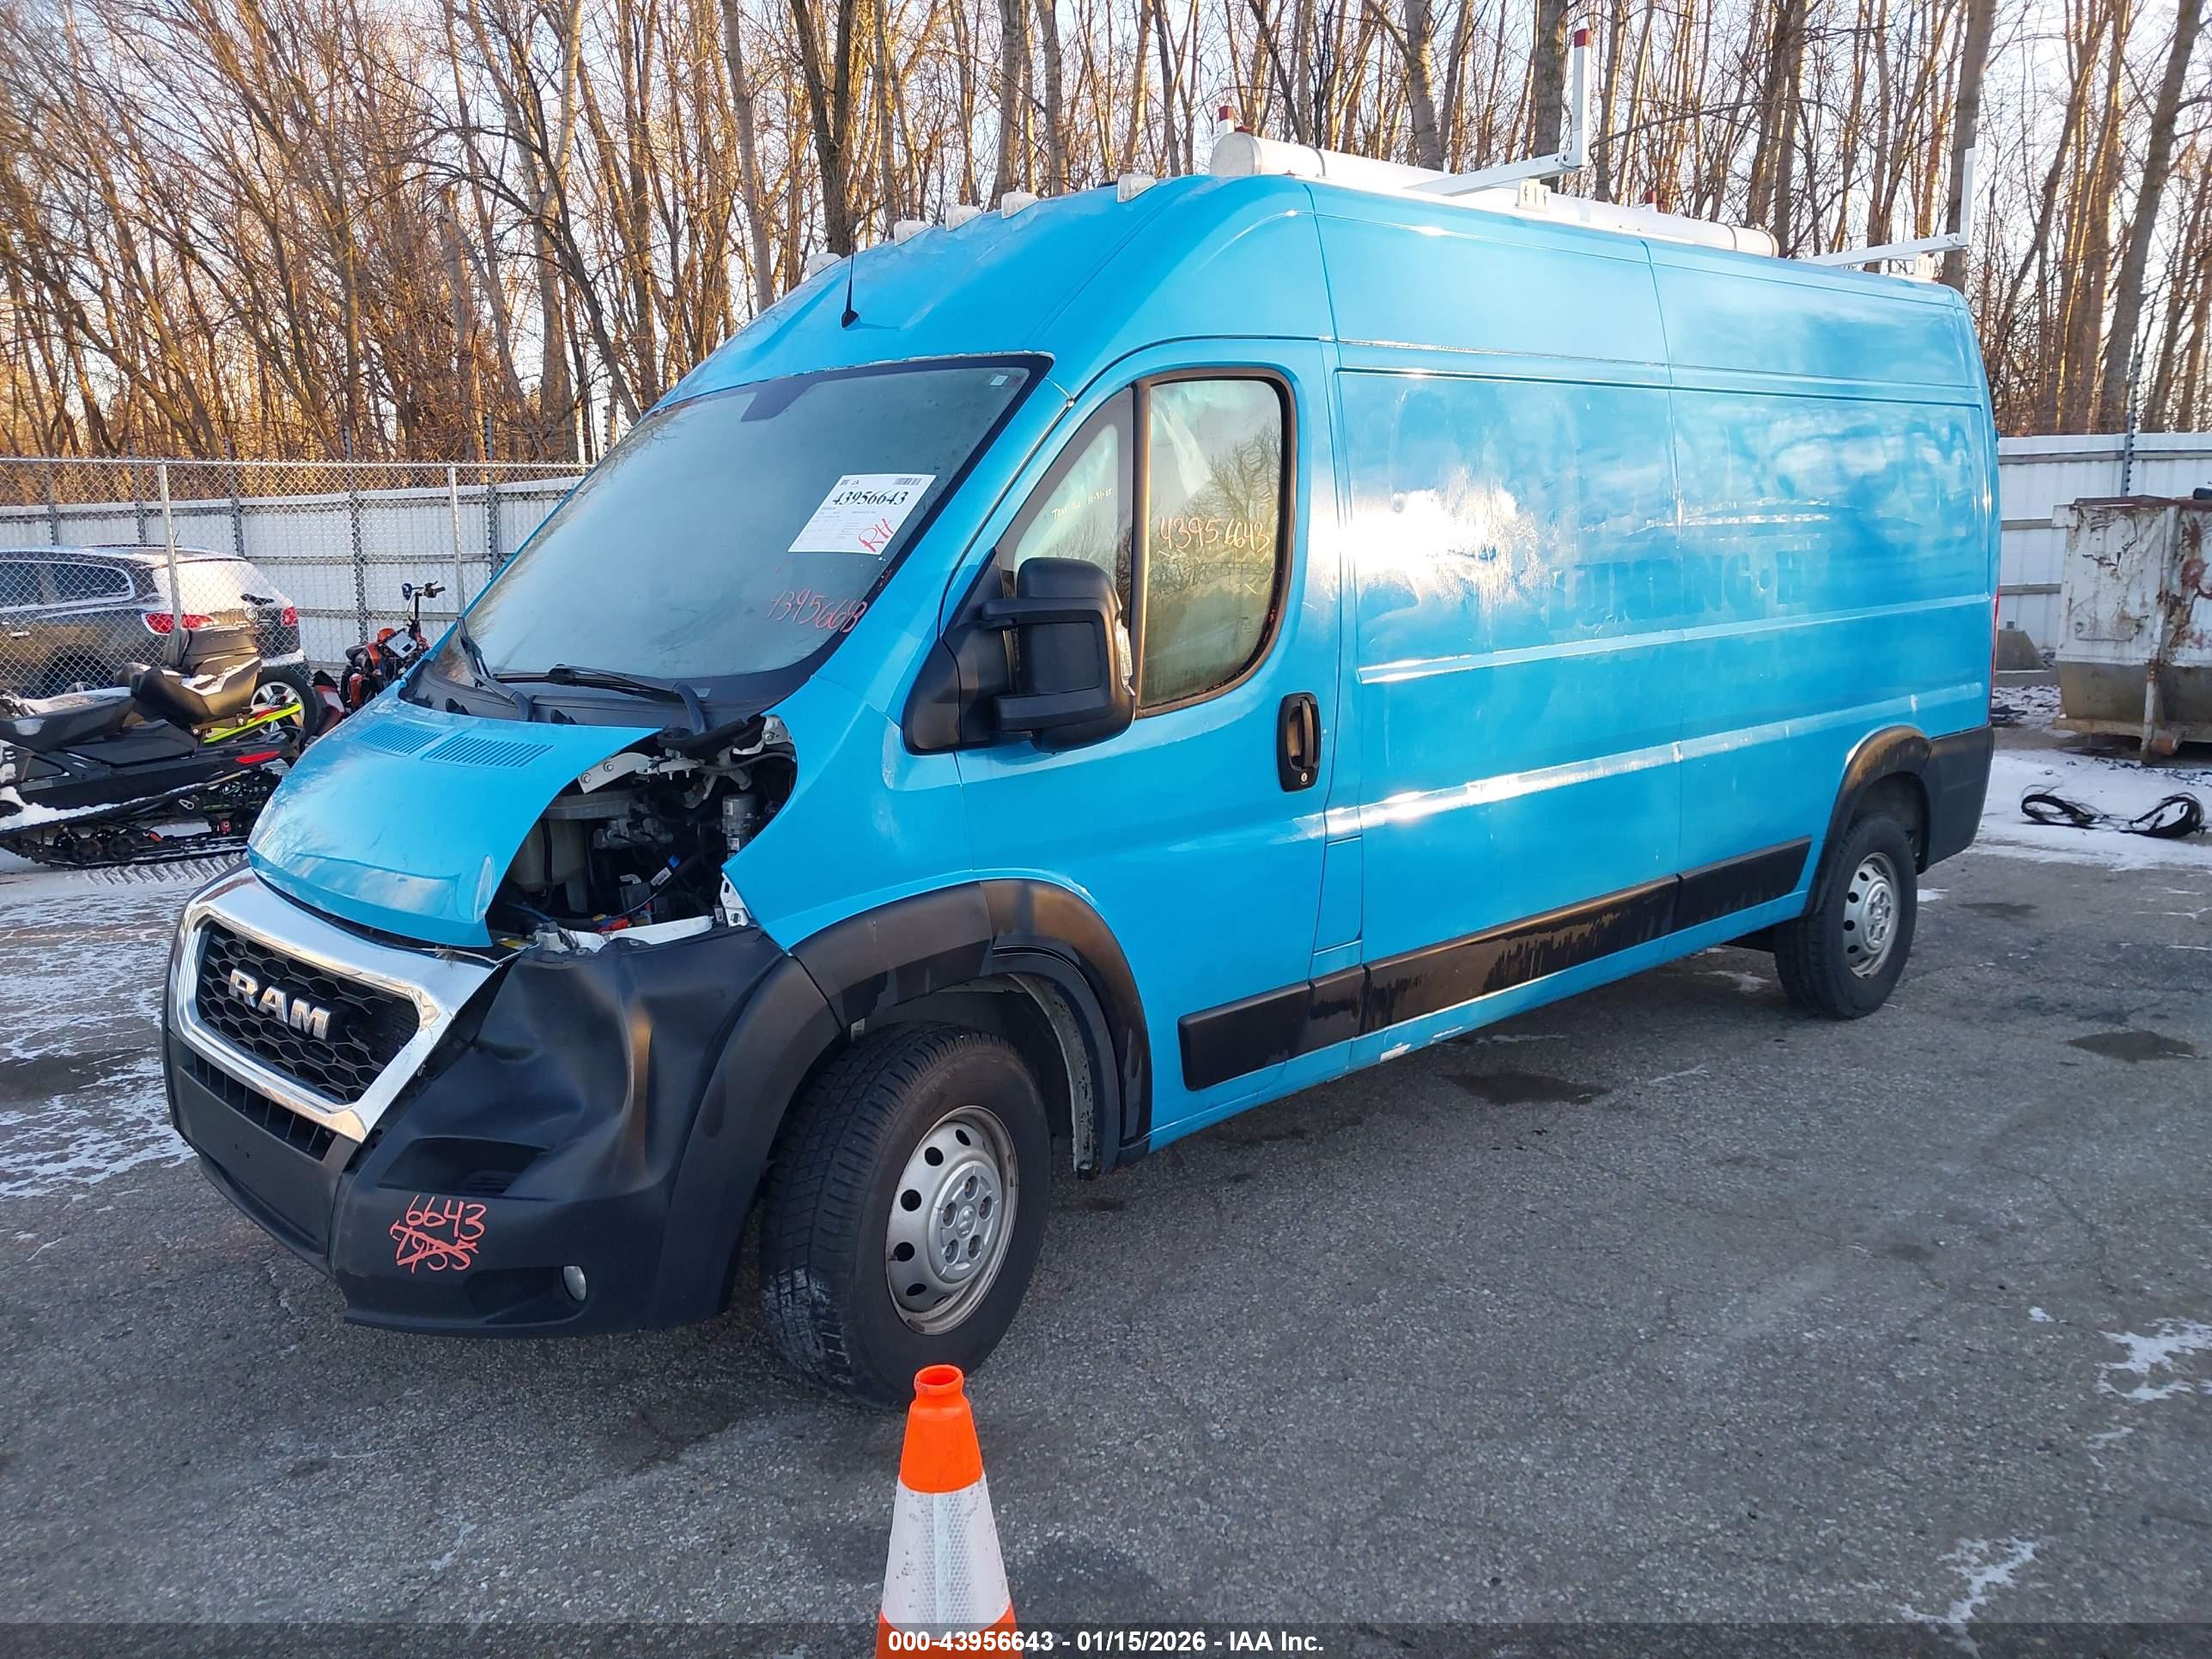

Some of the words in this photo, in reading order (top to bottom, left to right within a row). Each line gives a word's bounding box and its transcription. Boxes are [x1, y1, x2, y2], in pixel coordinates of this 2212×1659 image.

[833, 490, 908, 506] 43956643
[1160, 517, 1271, 553] 43956643
[228, 968, 331, 1040] RAM
[405, 1194, 487, 1241] 6643
